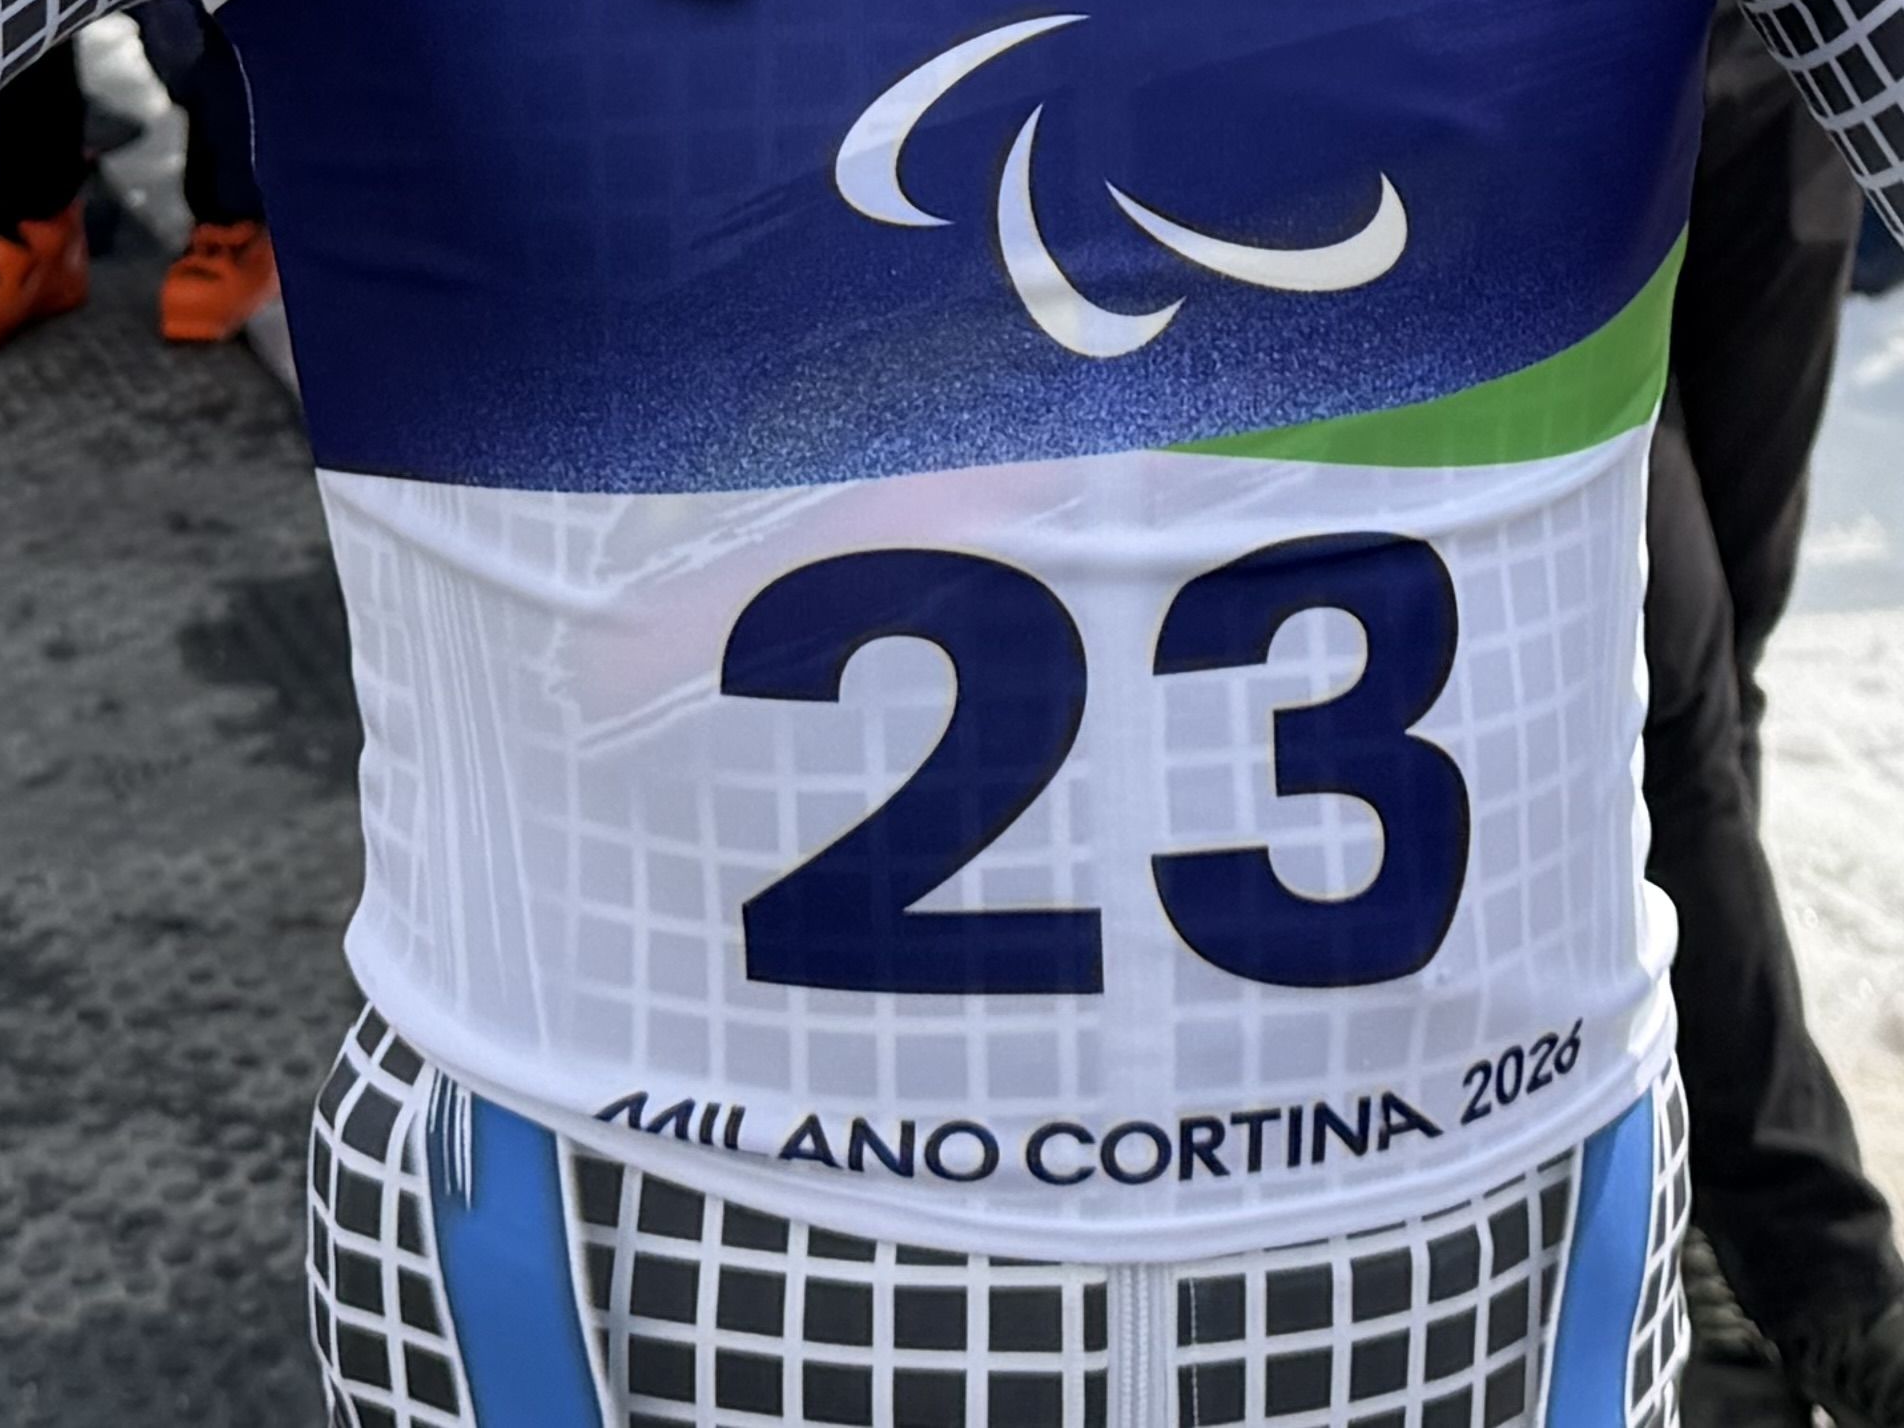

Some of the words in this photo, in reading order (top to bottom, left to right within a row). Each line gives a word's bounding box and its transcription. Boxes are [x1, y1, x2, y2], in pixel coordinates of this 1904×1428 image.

[718, 531, 1472, 994] 23
[1025, 1090, 1443, 1186] CORTINA
[1460, 1018, 1584, 1126] 2026
